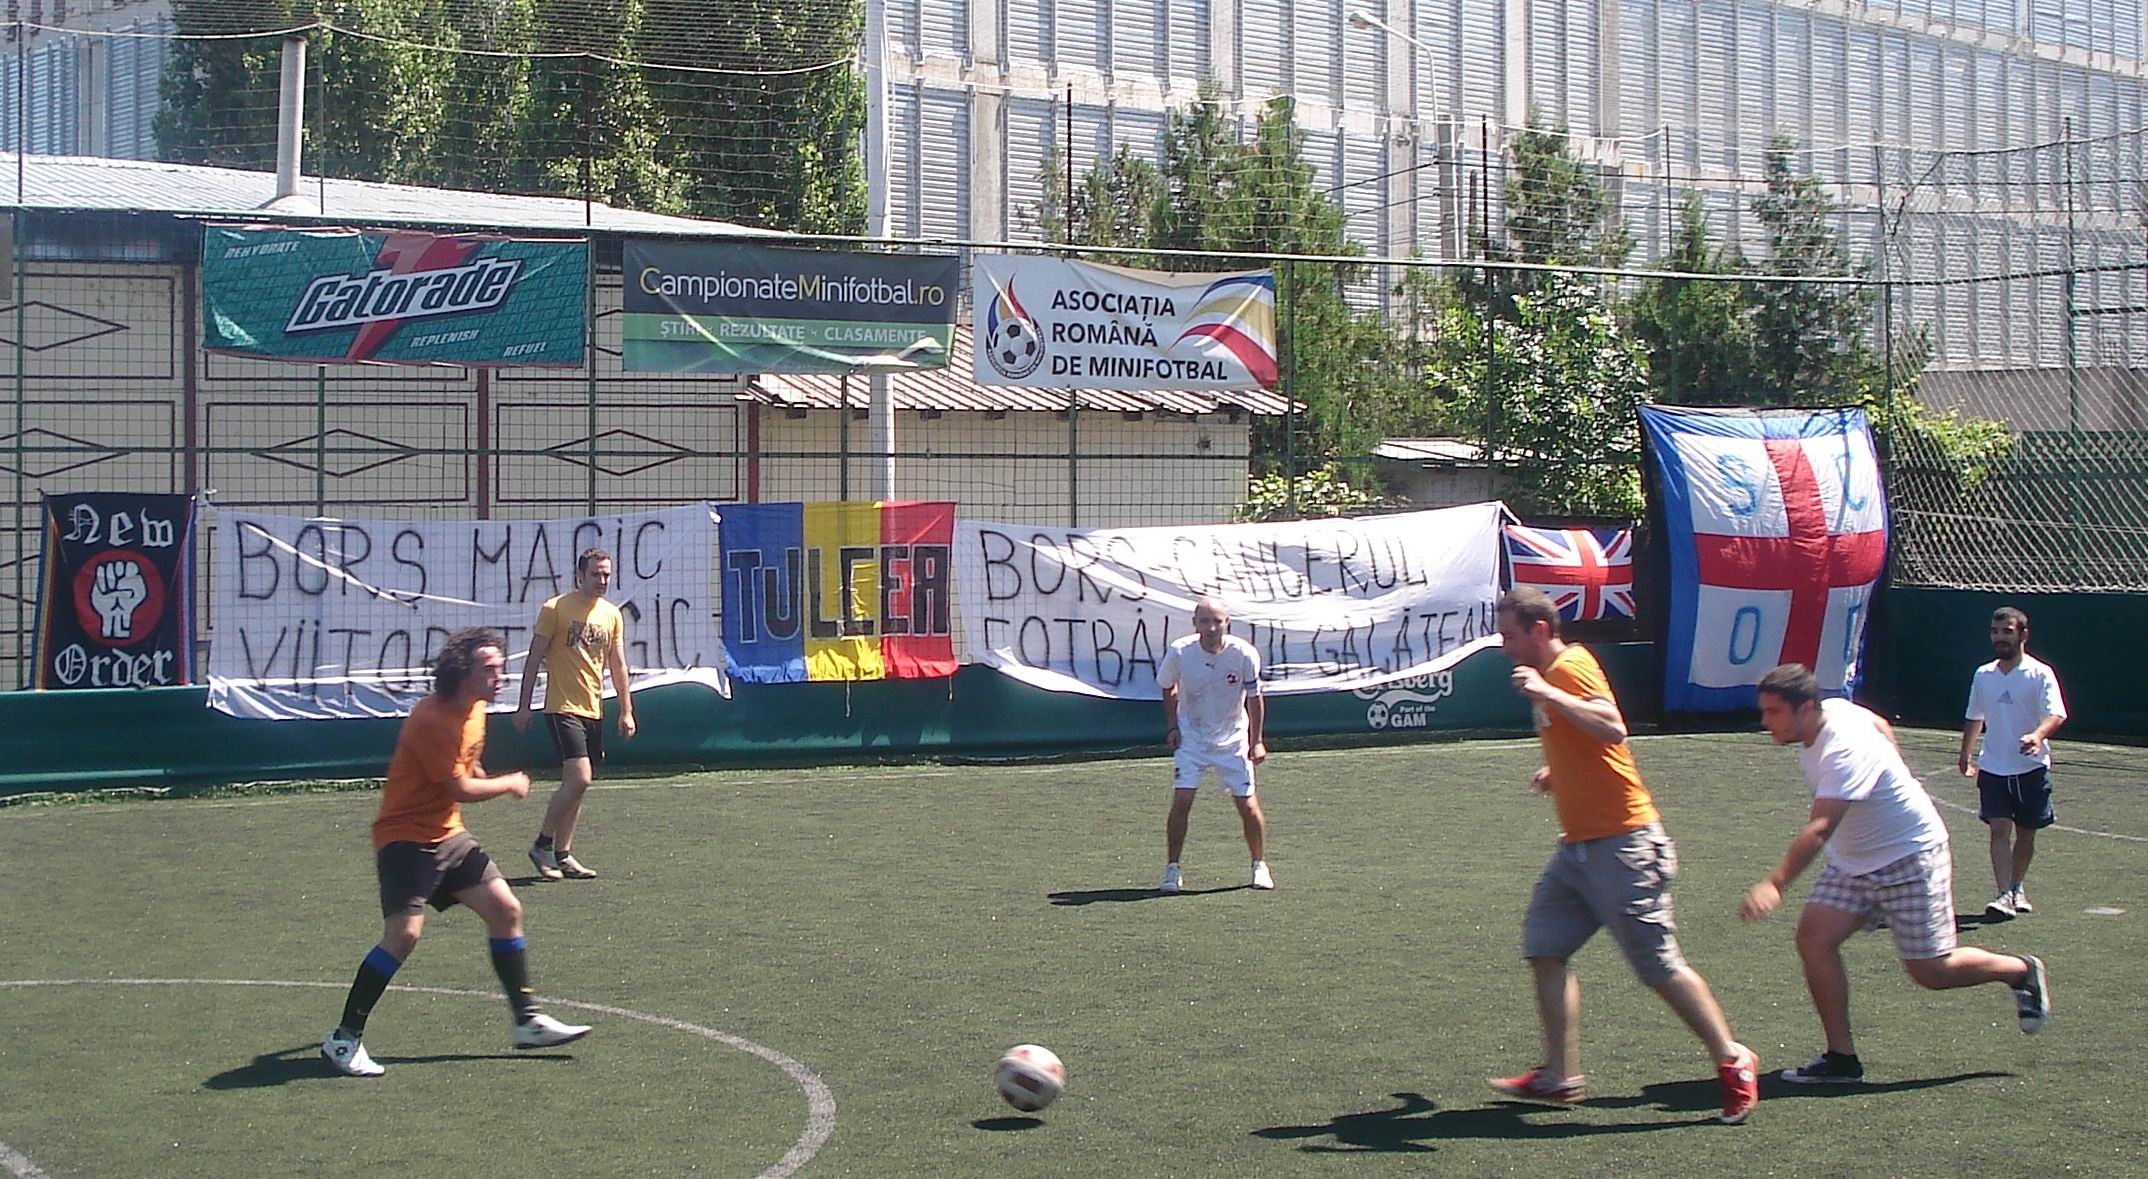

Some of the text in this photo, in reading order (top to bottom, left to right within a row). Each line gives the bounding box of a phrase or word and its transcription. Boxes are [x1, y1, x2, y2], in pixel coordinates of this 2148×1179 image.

[224, 240, 301, 259] REHYDRATE
[291, 260, 519, 328] Gatorade
[639, 266, 945, 307] CampionateMinifotbal.ro
[1051, 289, 1176, 322] ASOCIAȚIA
[410, 329, 480, 348] REPLENISH
[719, 321, 805, 341] REZULTATE
[824, 325, 927, 344] CLASAMENTE
[1051, 320, 1159, 347] ROMÂNĂ
[503, 342, 547, 357] REFUEL
[1051, 355, 1228, 381] DE MINIFOTBAL
[62, 503, 174, 548] New
[726, 542, 951, 644] TULCEA
[54, 643, 174, 688] Order
[1391, 713, 1427, 728] GAM
[1399, 705, 1414, 713] Part
